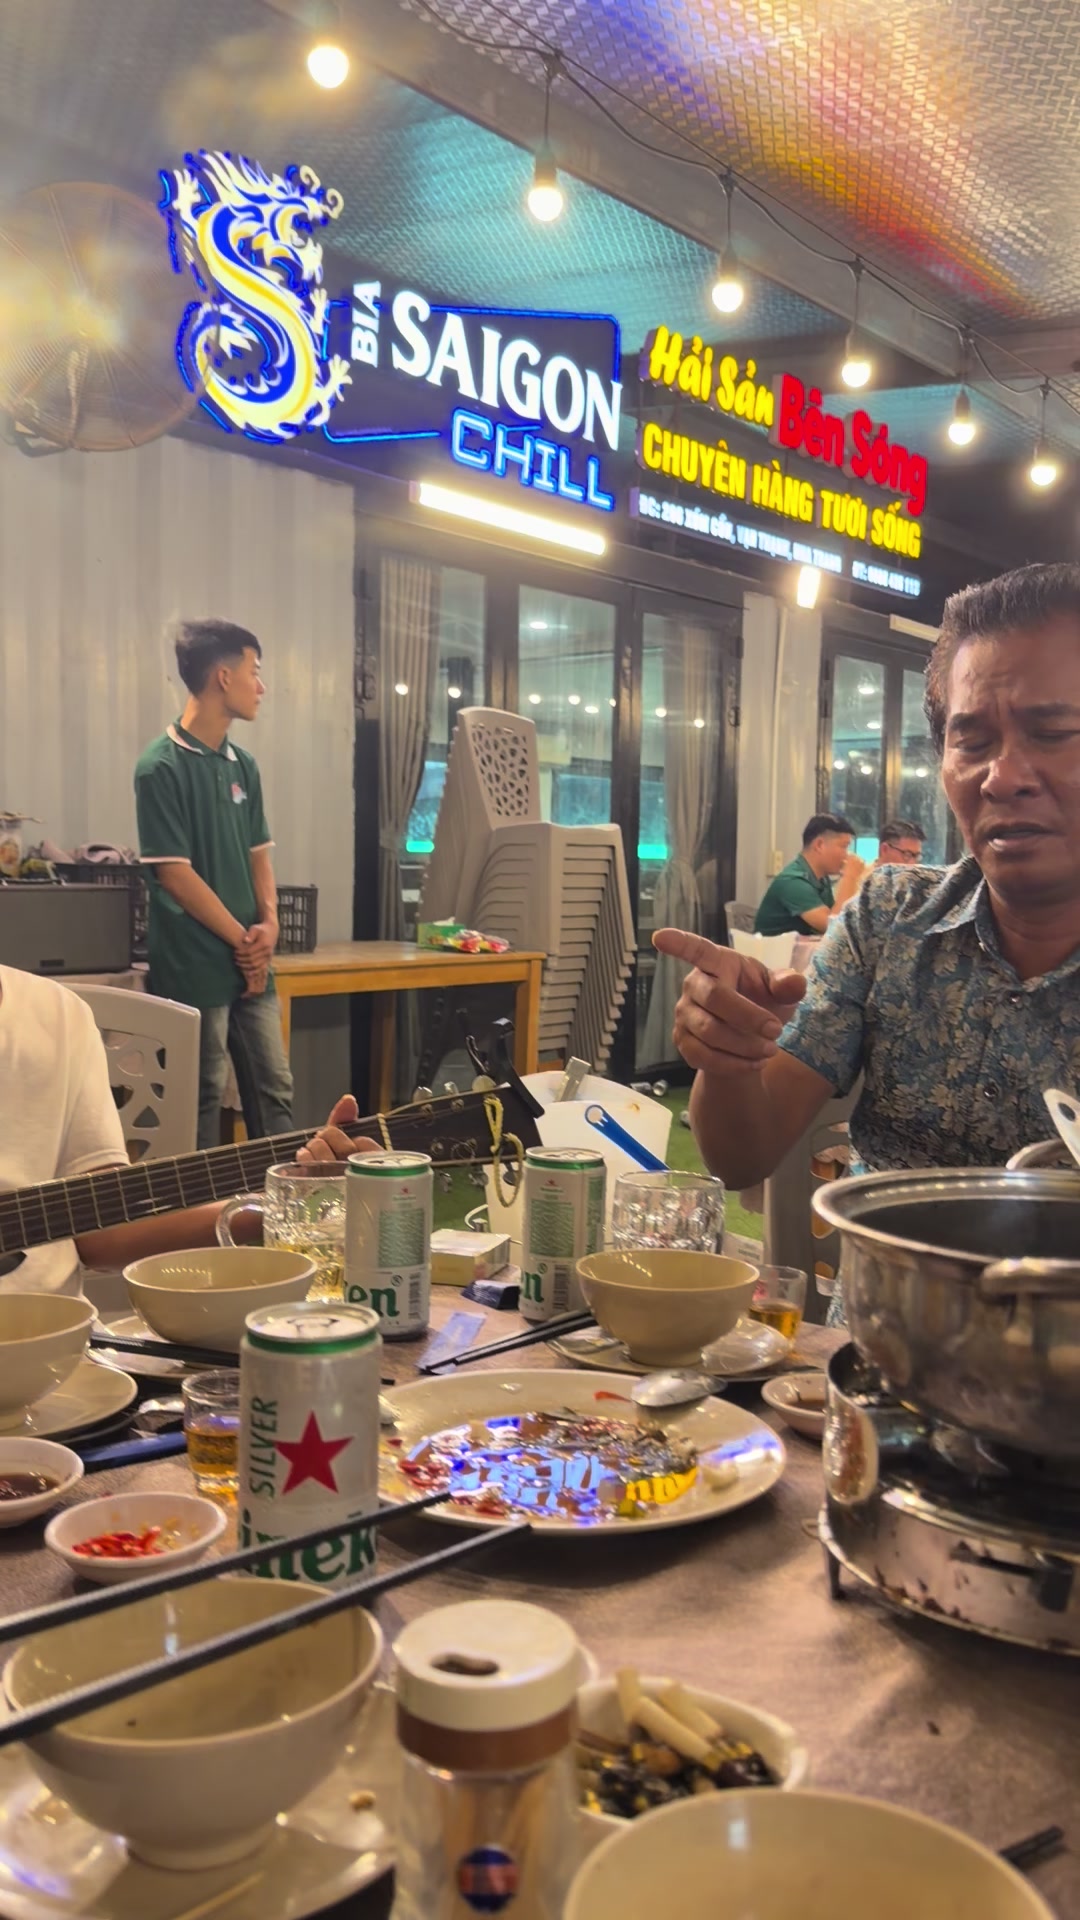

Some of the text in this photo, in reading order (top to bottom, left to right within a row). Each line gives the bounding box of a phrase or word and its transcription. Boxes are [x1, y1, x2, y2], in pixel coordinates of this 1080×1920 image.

[351, 280, 382, 368] BIA
[391, 290, 623, 451] SAIGON
[452, 407, 614, 511] CHILL
[649, 325, 713, 402] Hải
[716, 355, 774, 427] Sản
[851, 410, 928, 517] Sóng
[643, 422, 921, 559] CHUYÊN HÀNG TƯƠI SỐNG
[250, 1396, 278, 1499] SILVER
